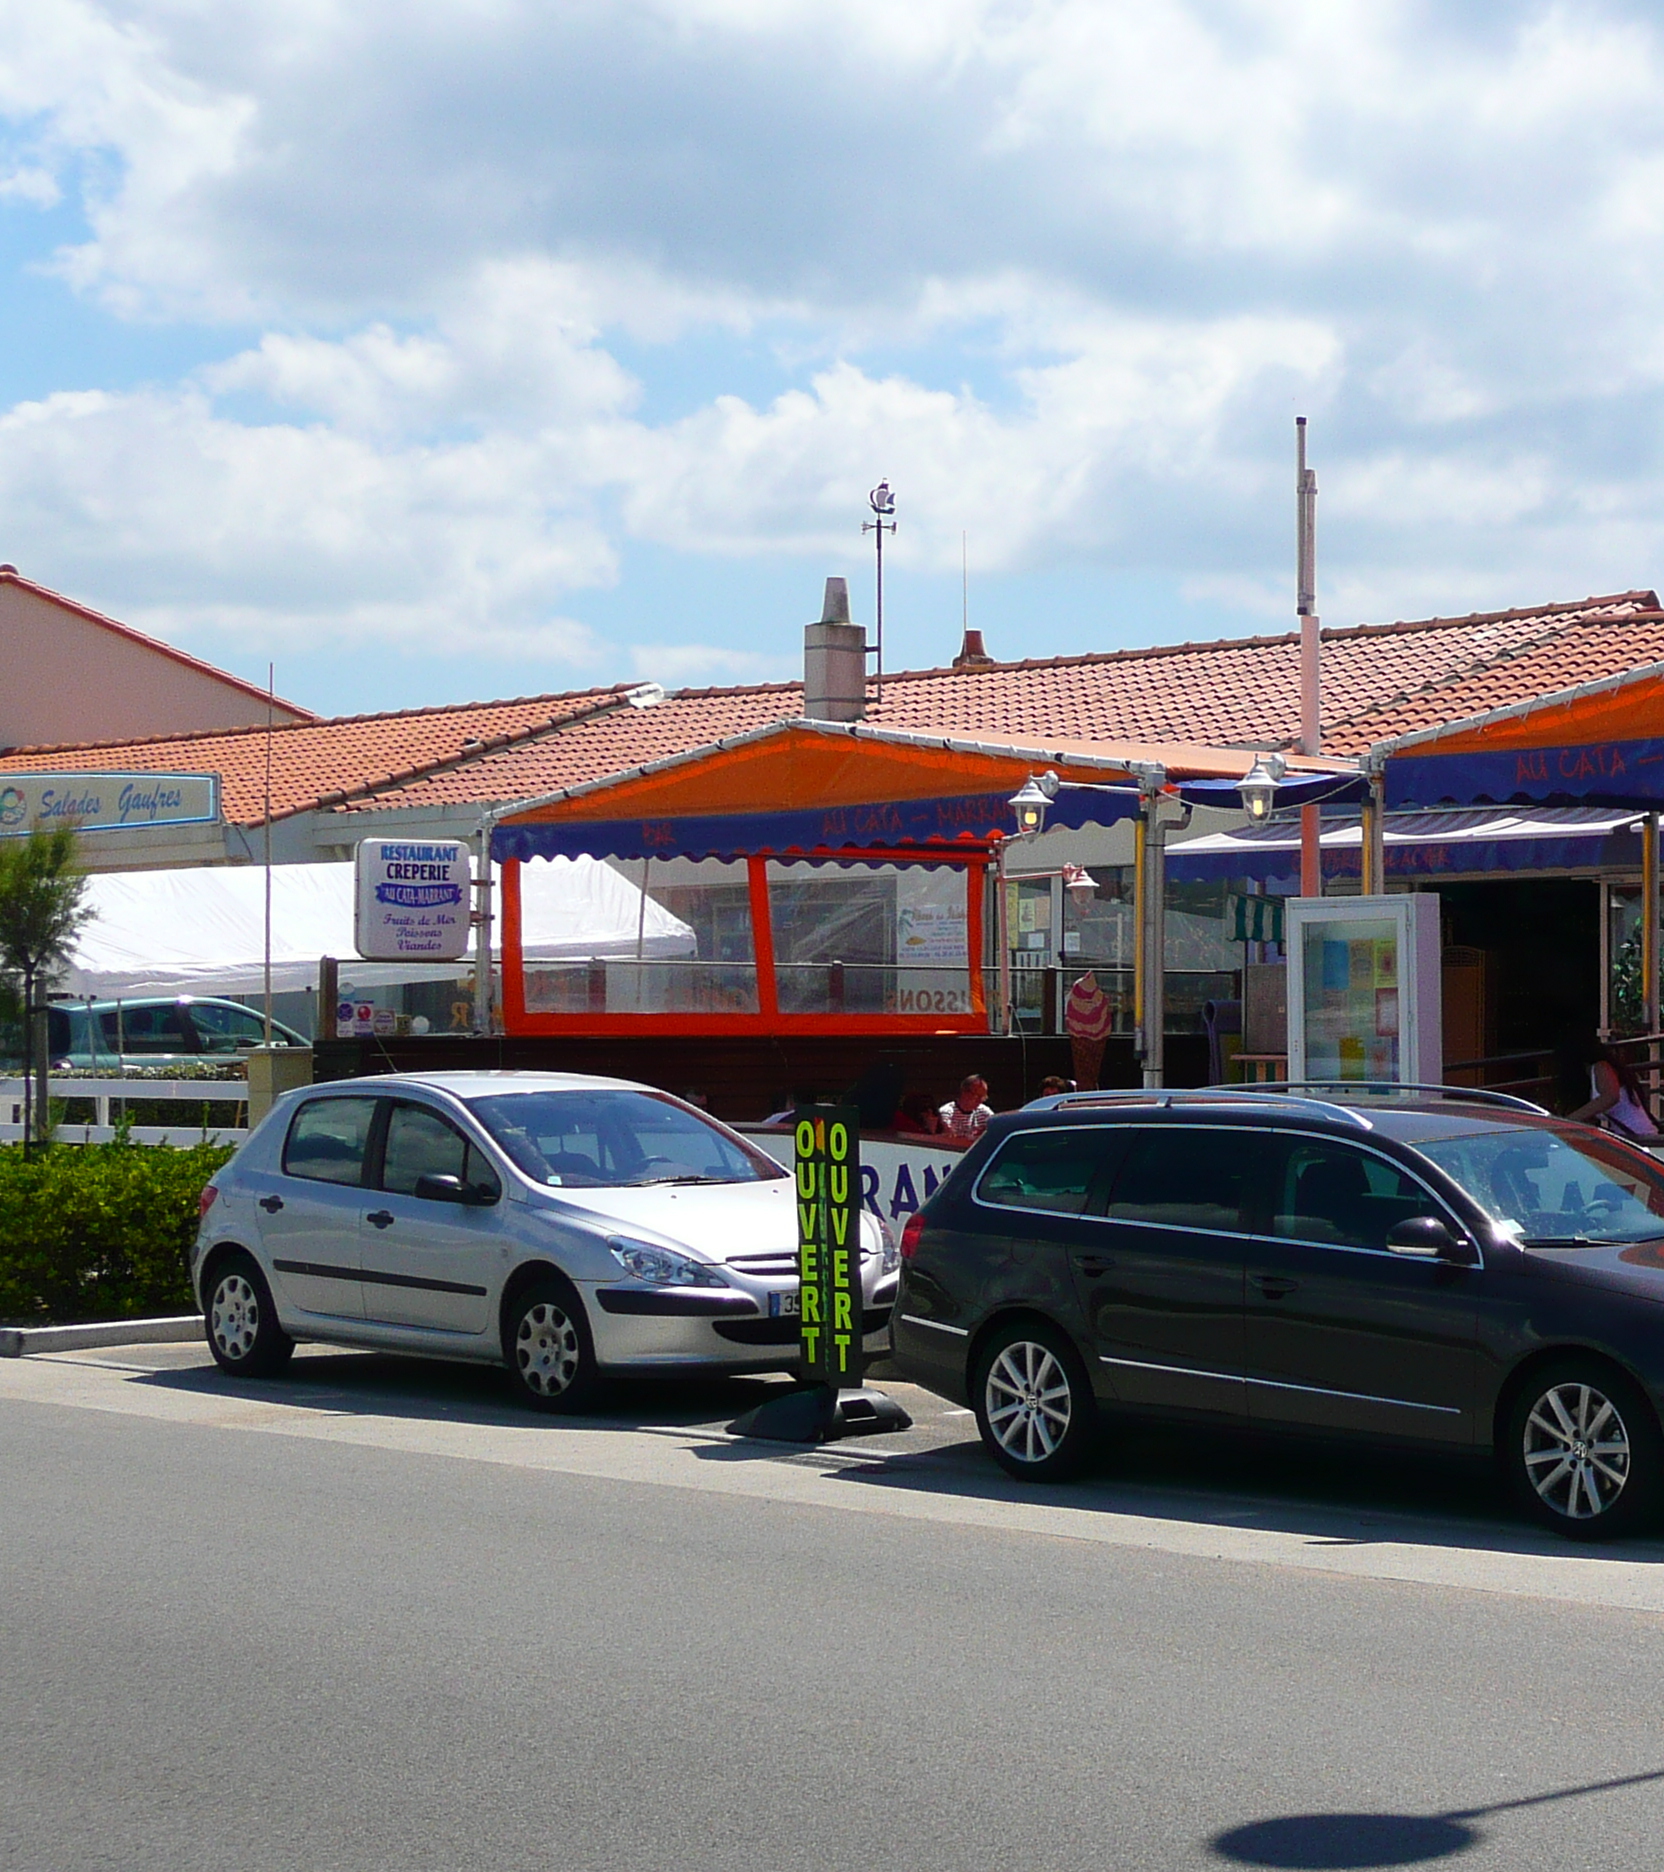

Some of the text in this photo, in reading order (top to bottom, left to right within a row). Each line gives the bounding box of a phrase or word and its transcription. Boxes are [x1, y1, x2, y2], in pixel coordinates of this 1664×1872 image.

[1516, 754, 1548, 784] AU
[1558, 746, 1625, 779] CATA
[39, 783, 181, 823] Salades Gaufres
[823, 812, 847, 837] AU
[853, 803, 902, 834] CATA
[641, 822, 677, 847] BAR
[381, 844, 459, 861] RESTAURANT
[386, 863, 450, 881] CREPERIE
[383, 913, 456, 926] Fruits de Mer
[395, 927, 442, 938] Poissons
[397, 940, 442, 951] Viandes
[795, 1120, 821, 1364] OUVERT
[830, 1122, 852, 1373] OUVERT
